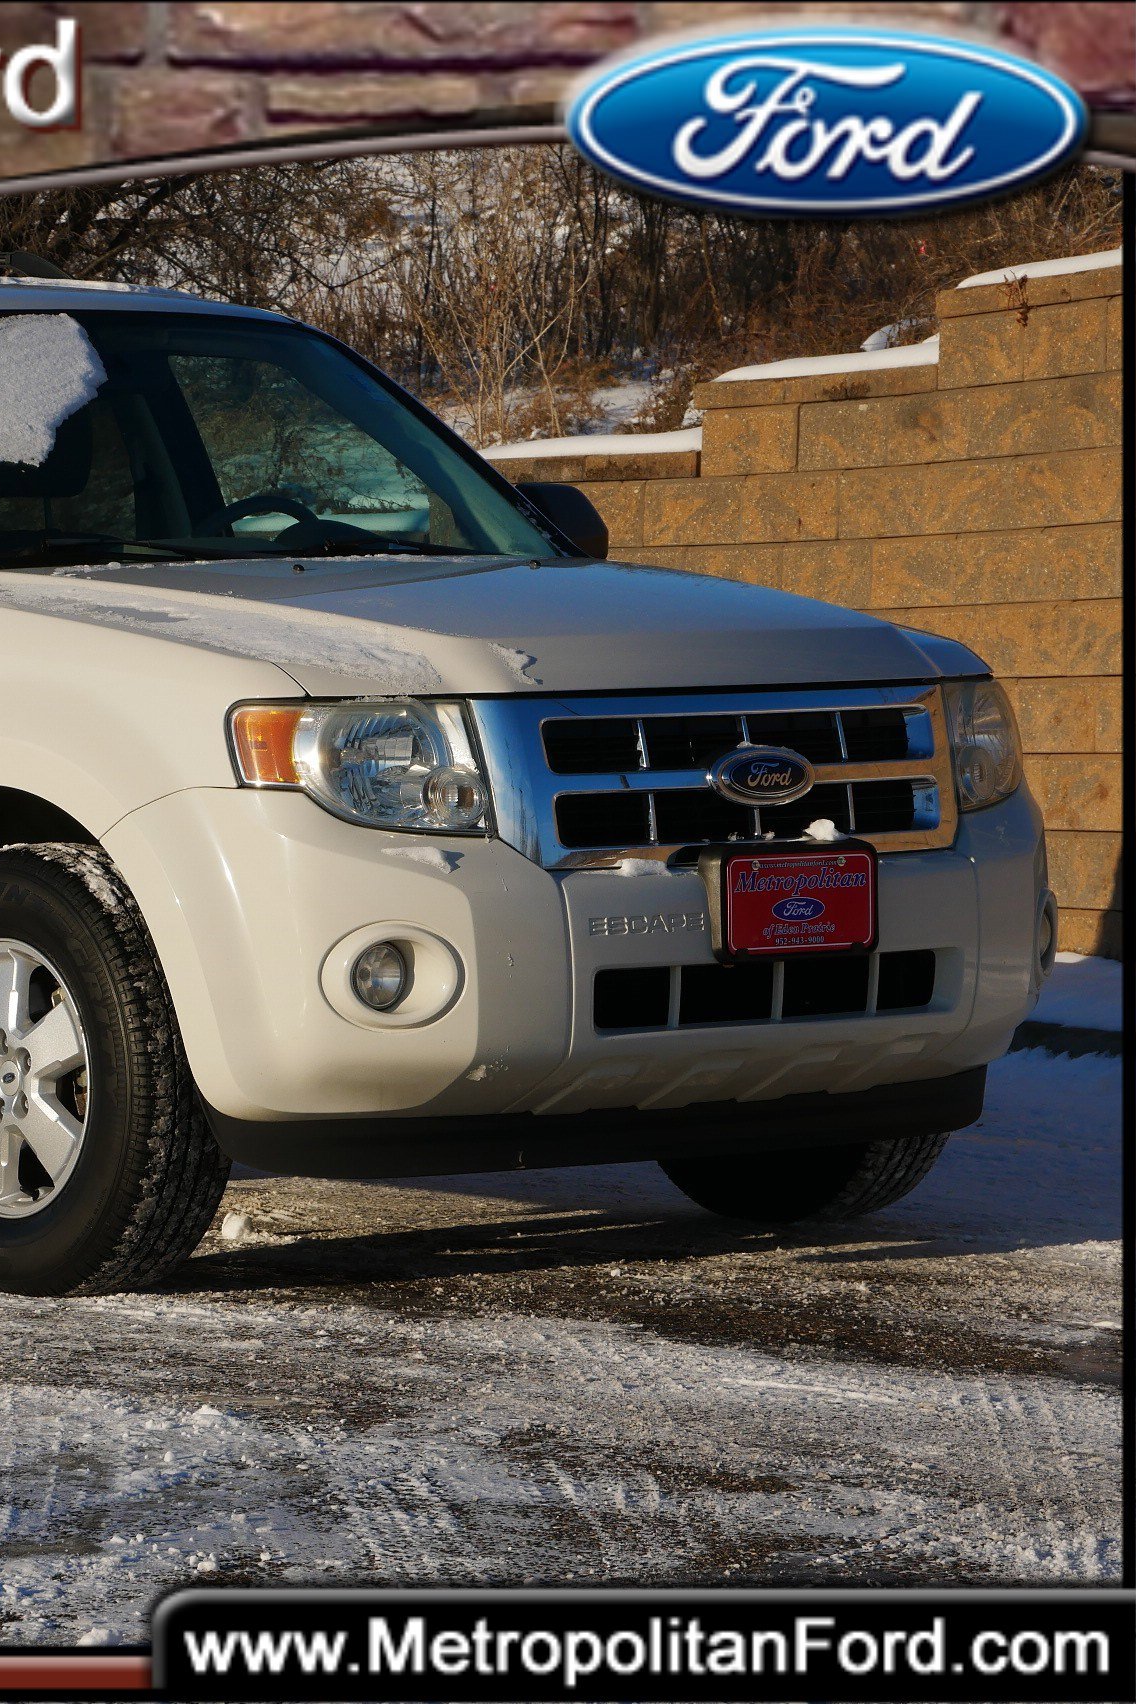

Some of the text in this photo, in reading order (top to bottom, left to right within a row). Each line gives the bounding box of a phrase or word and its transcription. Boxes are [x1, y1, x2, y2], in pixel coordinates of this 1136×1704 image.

[747, 761, 792, 787] Ford
[734, 867, 867, 896] Metropolitan
[783, 901, 814, 916] Ford
[588, 912, 705, 937] ESCAPE
[774, 923, 800, 935] Eden
[801, 921, 836, 933] Prairie
